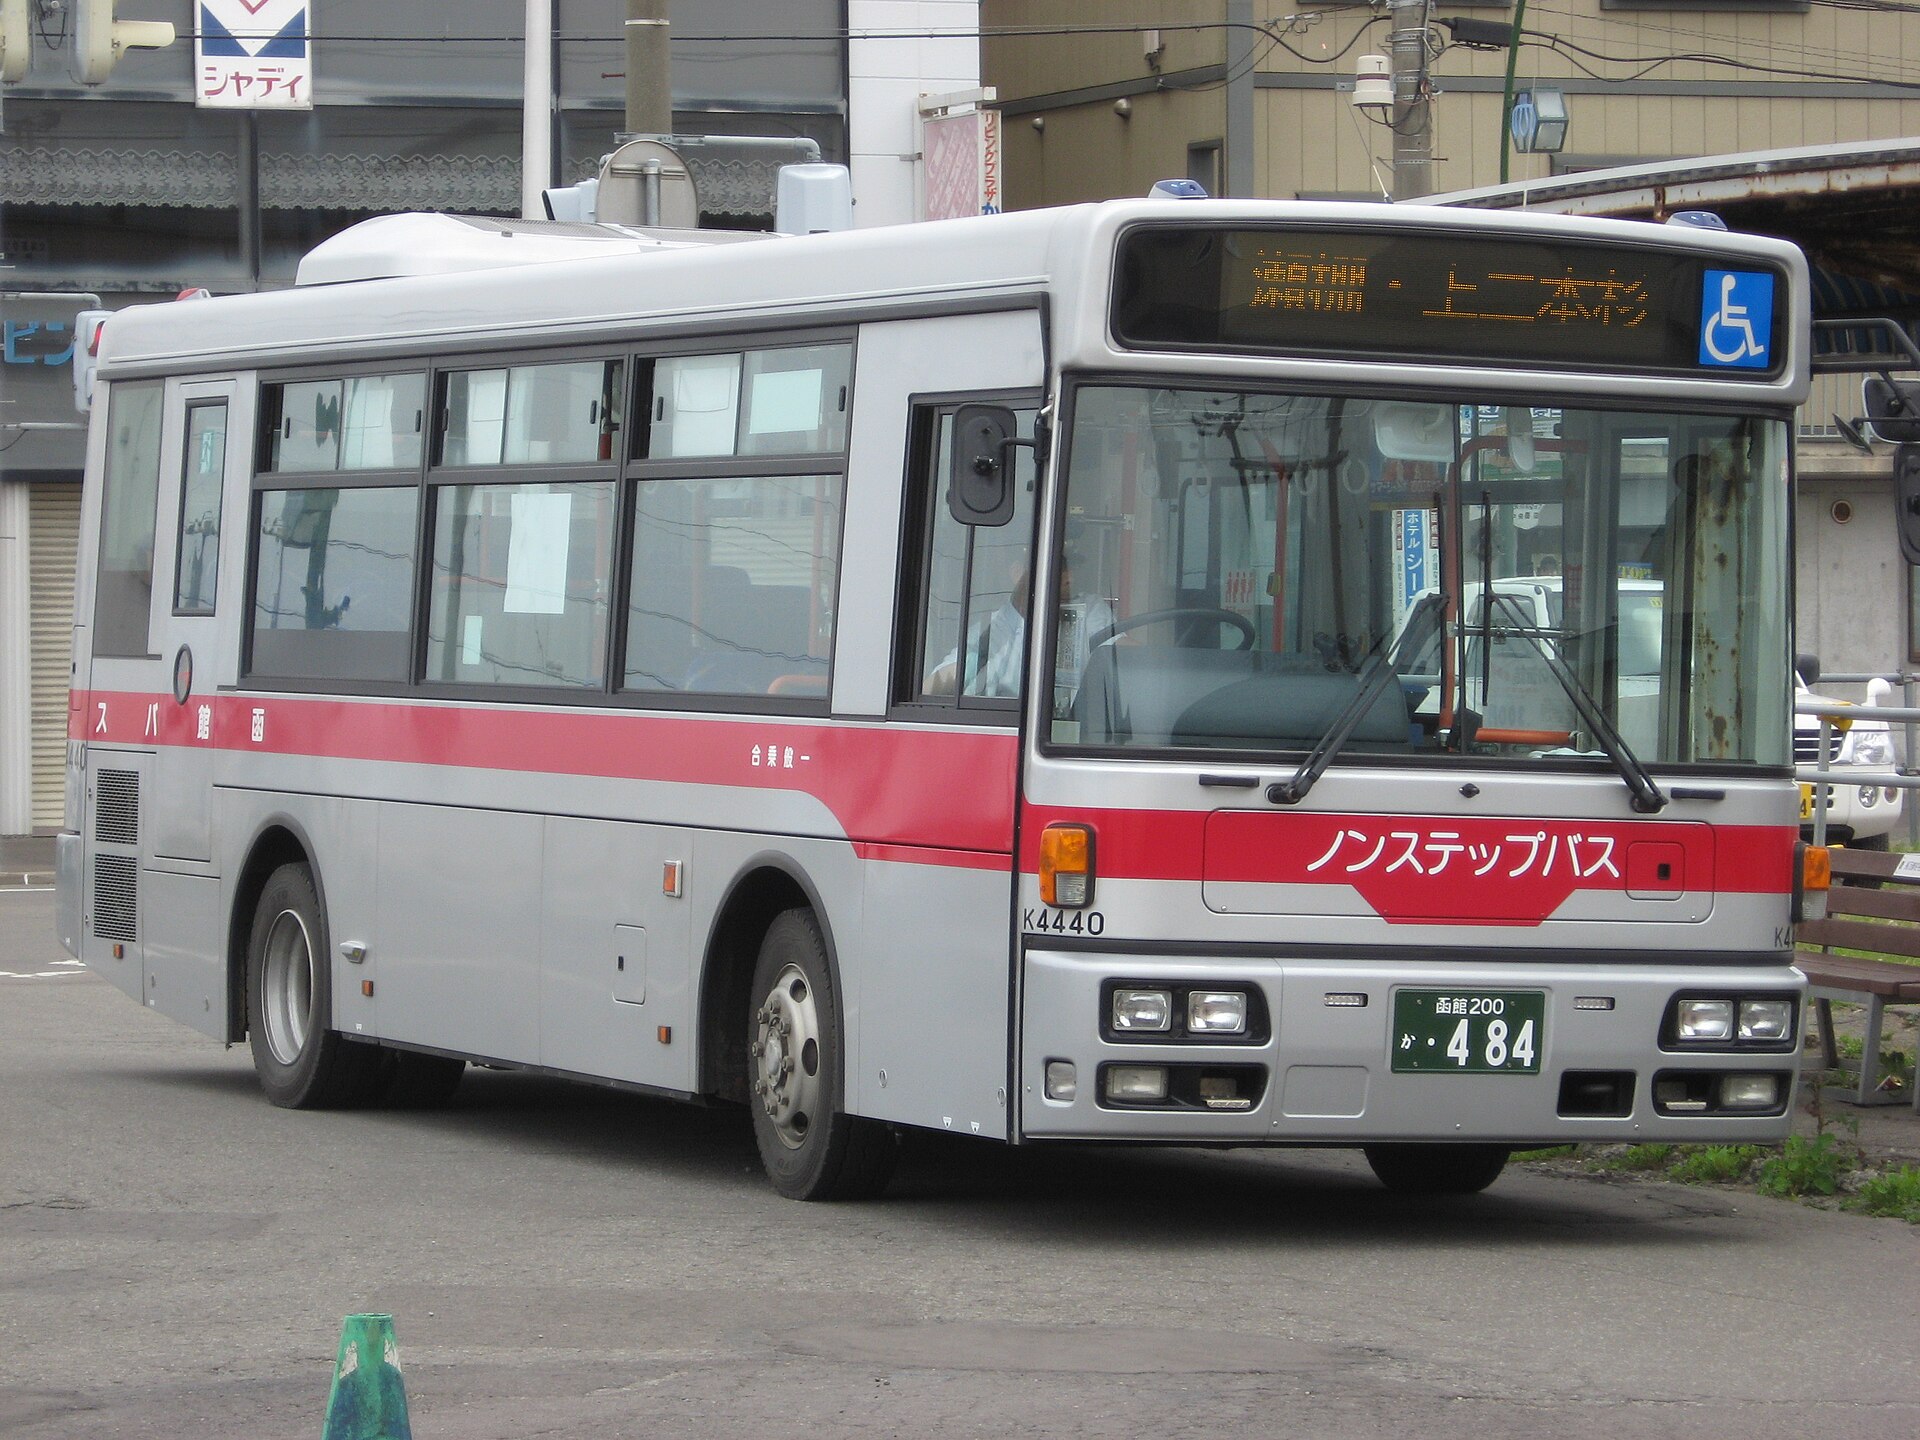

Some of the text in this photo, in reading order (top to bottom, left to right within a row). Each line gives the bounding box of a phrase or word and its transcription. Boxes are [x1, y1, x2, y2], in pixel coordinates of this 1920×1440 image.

[204, 66, 304, 98] シャディ
[985, 112, 997, 201] リビングプラザ
[1407, 512, 1422, 600] ホテルシー
[1307, 830, 1620, 878] ノンステップバス
[1023, 908, 1105, 936] K4440
